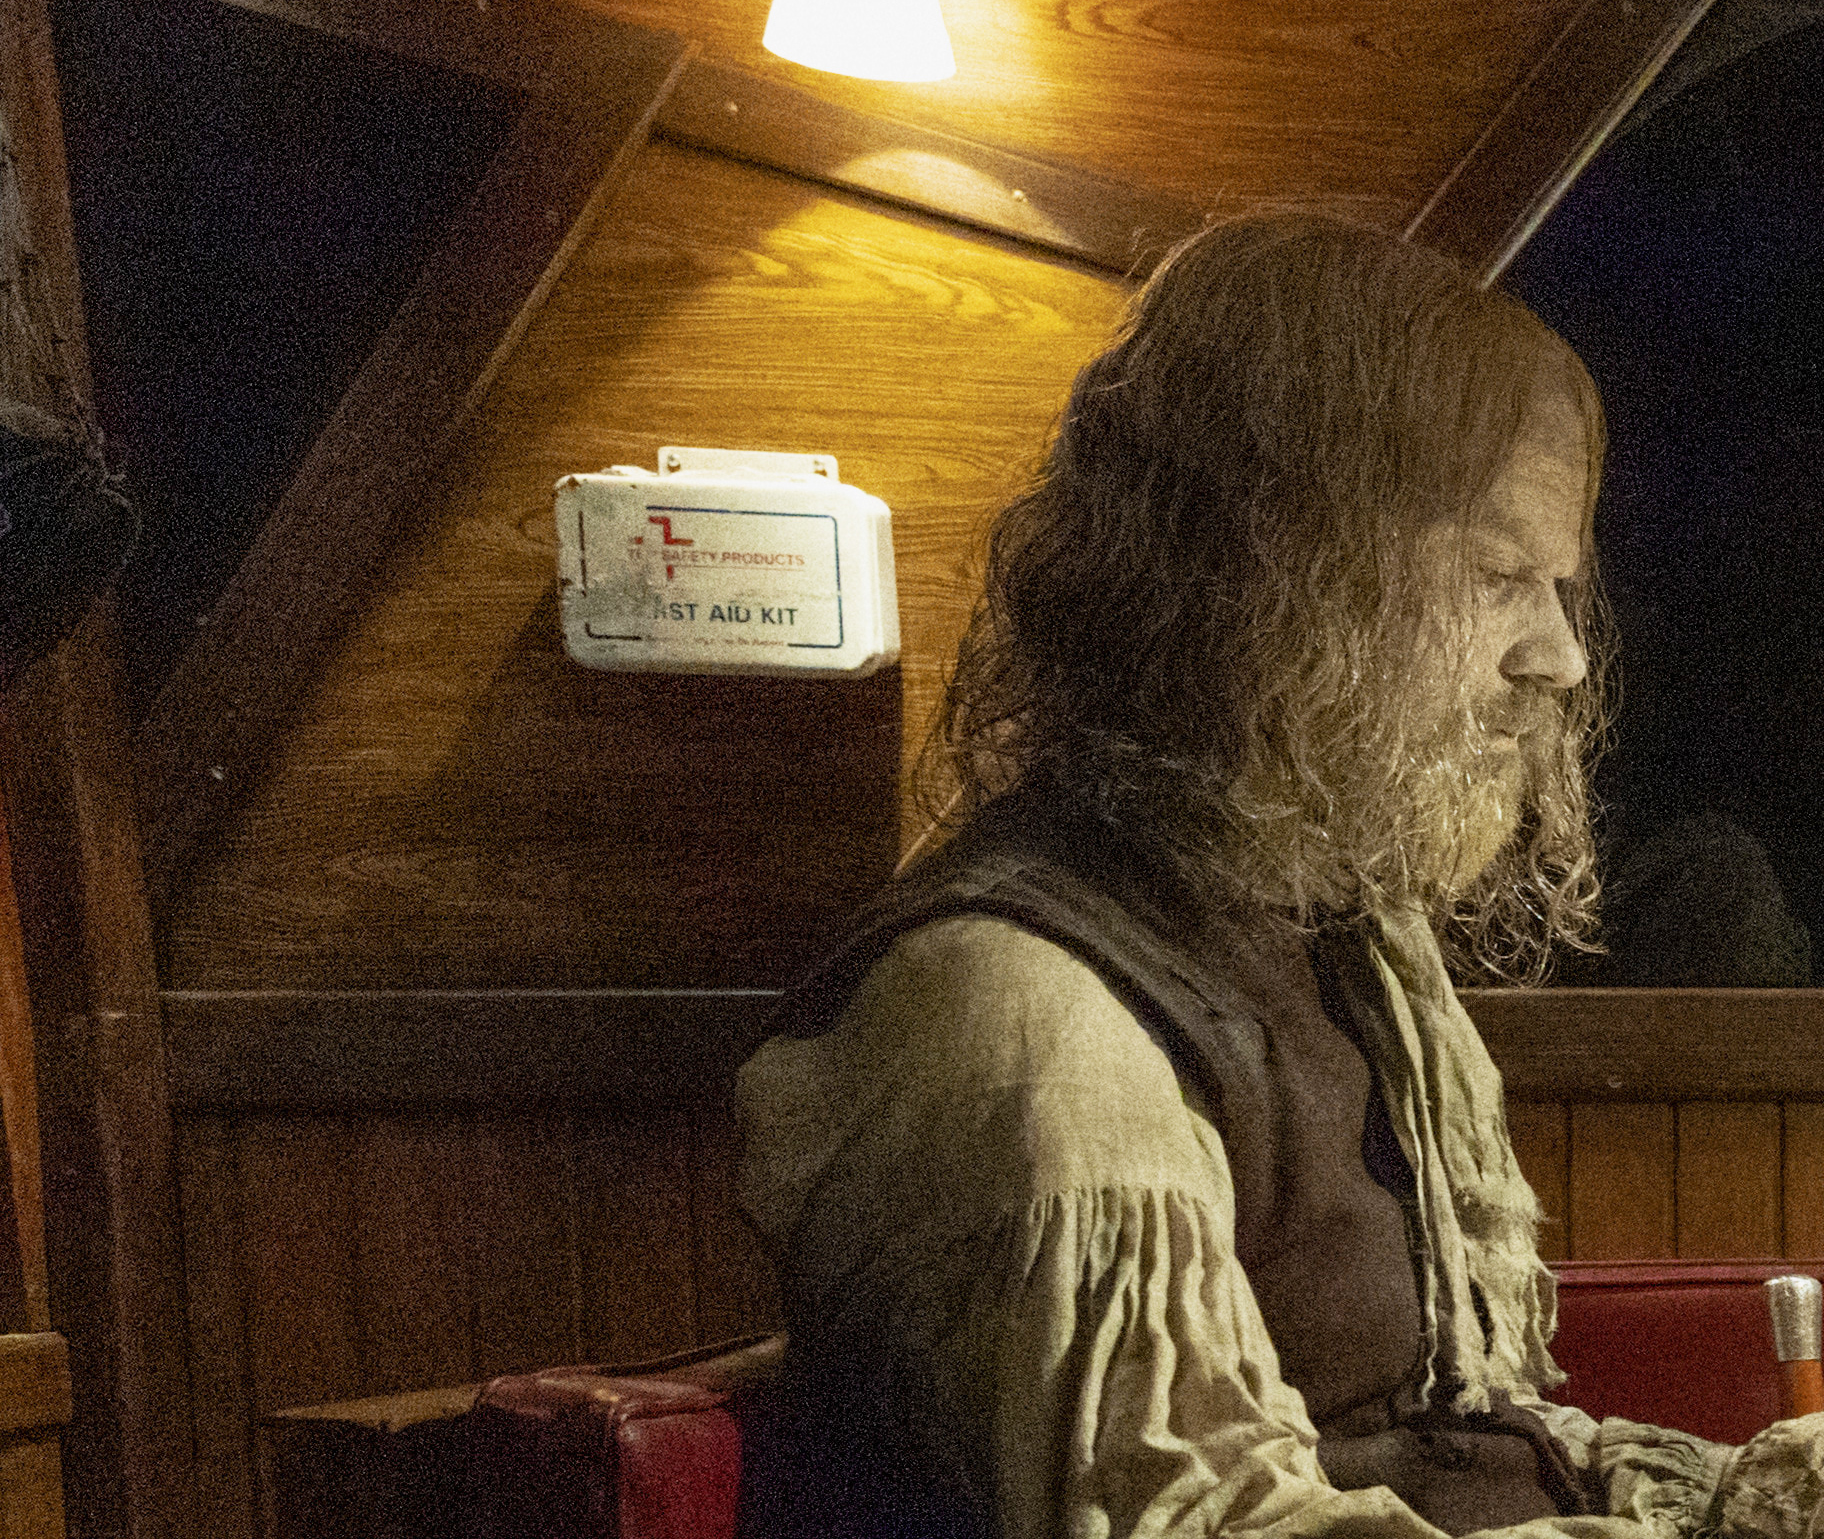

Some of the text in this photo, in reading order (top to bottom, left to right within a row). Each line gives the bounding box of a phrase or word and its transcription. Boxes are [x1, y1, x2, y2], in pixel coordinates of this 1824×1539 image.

[662, 550, 717, 563] SAFETY
[722, 552, 805, 565] PRODUCTS
[709, 604, 751, 623] AID
[761, 607, 798, 625] KIT
